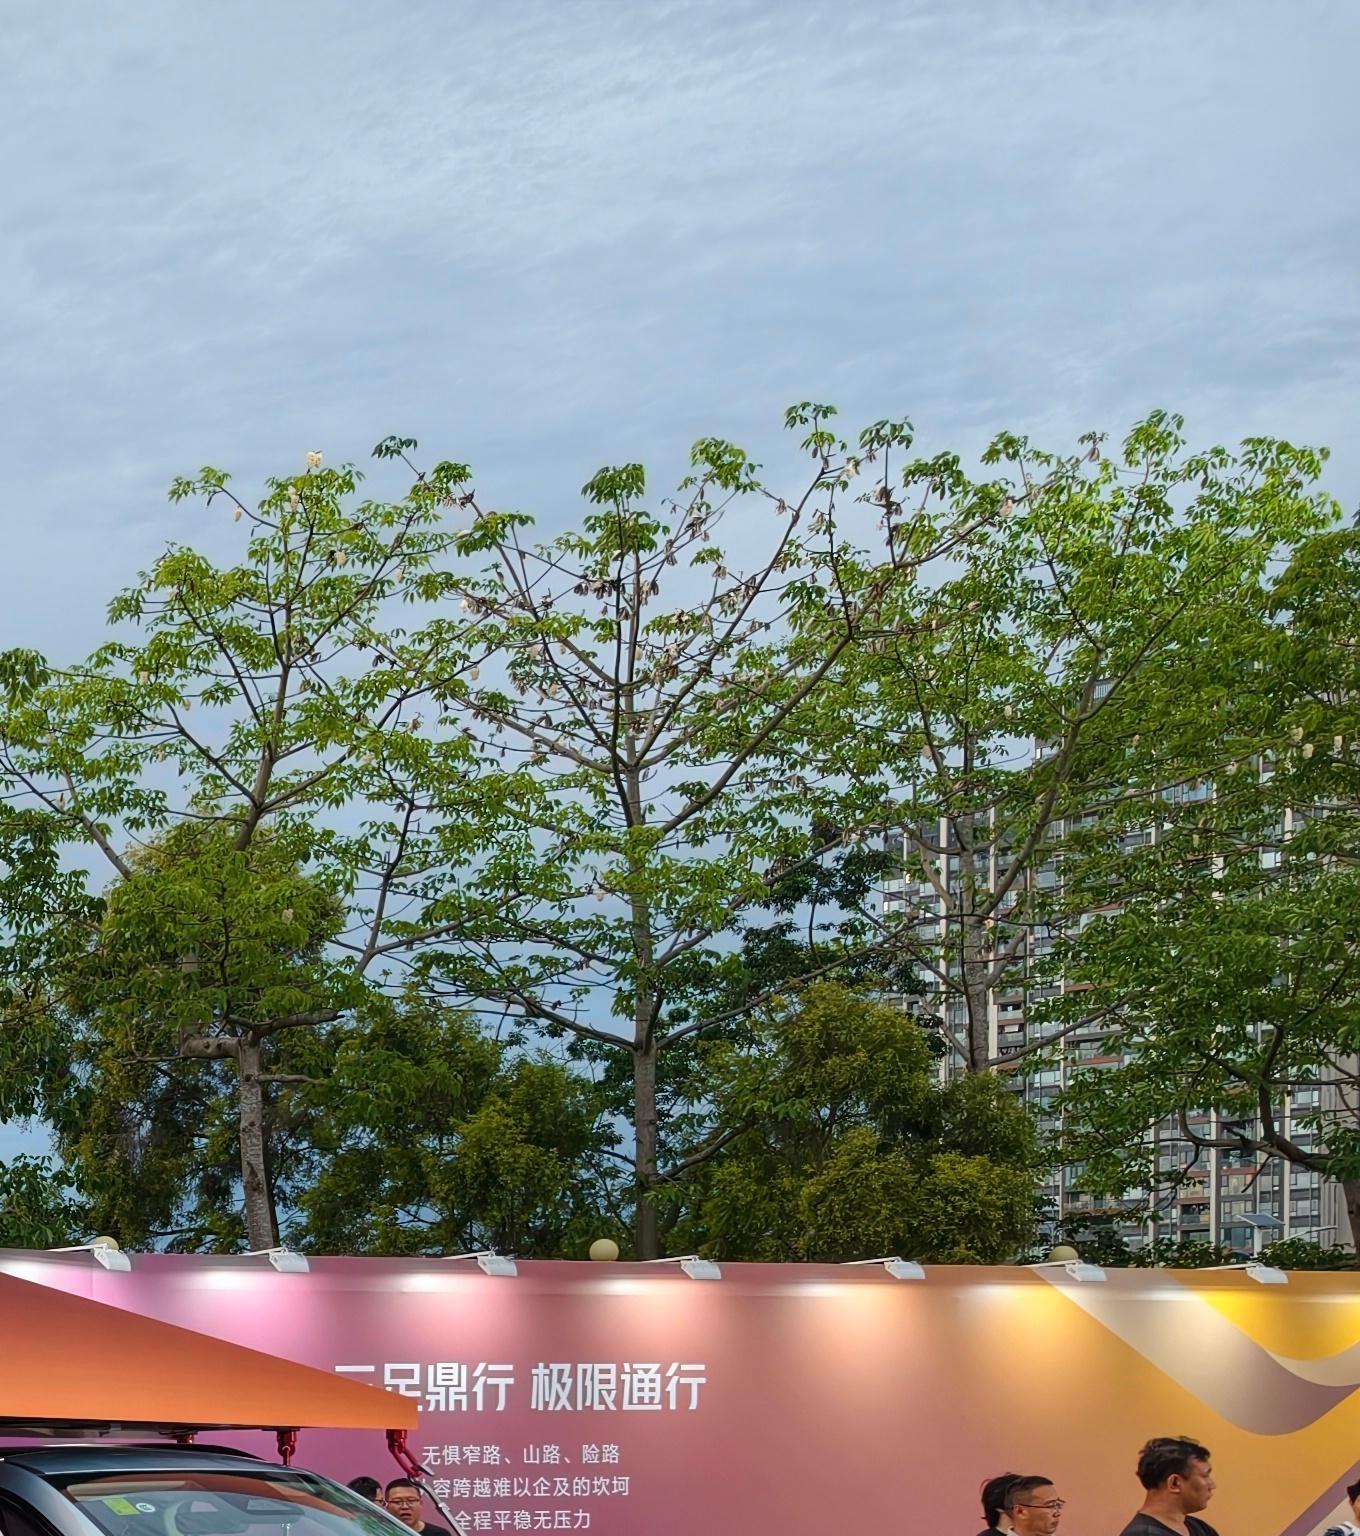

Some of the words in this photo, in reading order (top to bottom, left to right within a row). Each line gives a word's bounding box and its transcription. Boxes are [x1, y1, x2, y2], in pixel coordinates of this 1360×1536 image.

[531, 1362, 707, 1411] 极限通行
[421, 1443, 621, 1466] 无惧窄路、山路、险路
[454, 1509, 591, 1531] 全程平稳无压力
